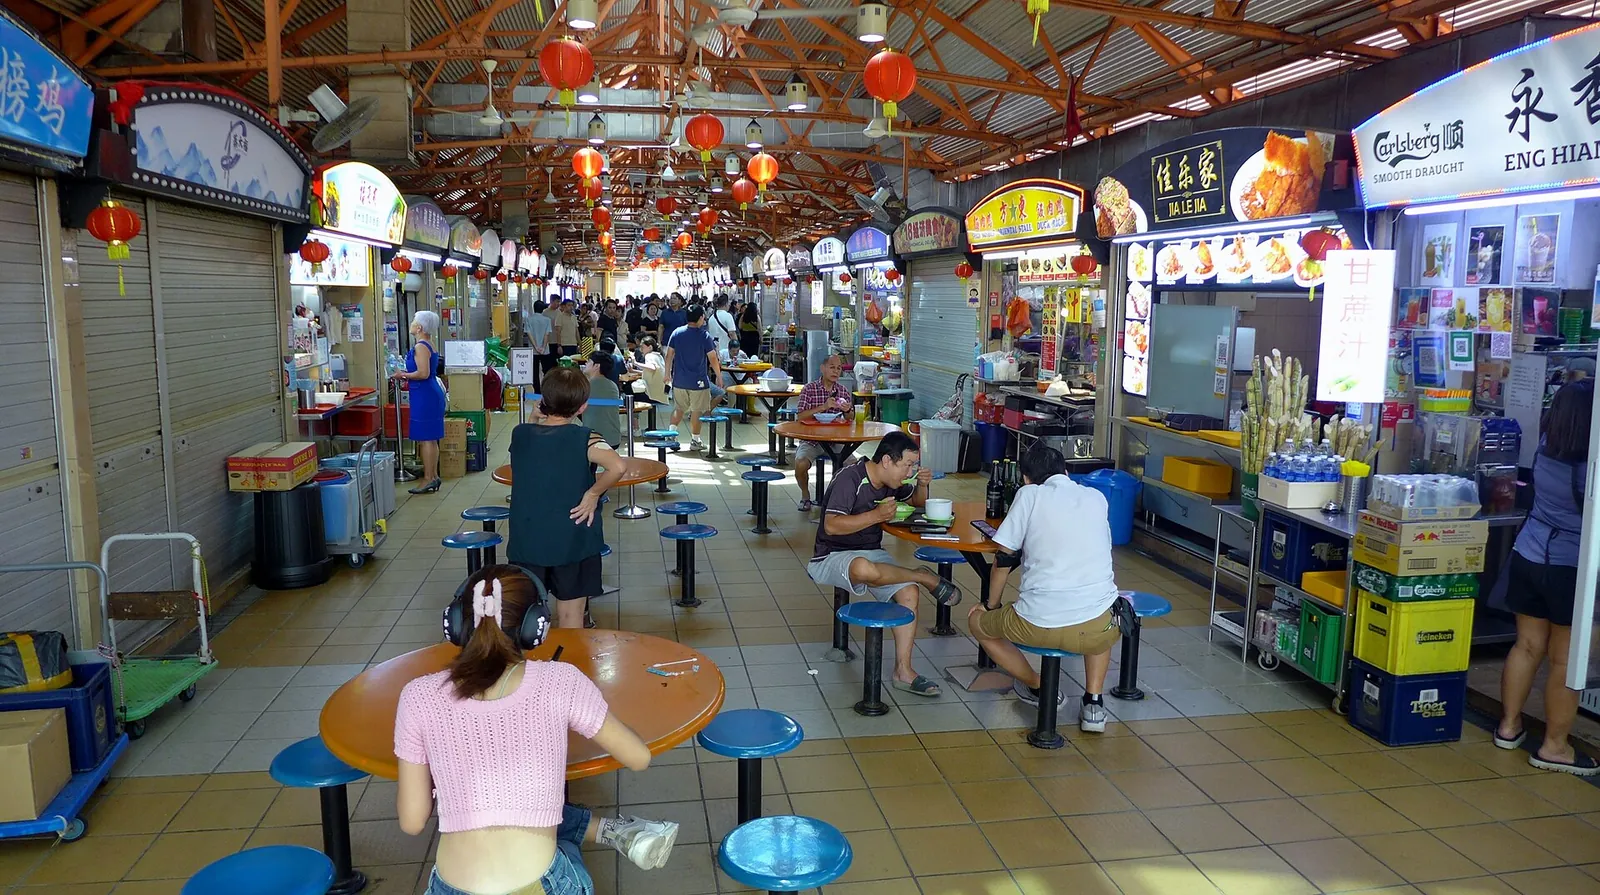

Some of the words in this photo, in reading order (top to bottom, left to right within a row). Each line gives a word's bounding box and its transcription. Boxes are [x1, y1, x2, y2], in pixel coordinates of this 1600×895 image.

[1373, 126, 1440, 163] Carlsberg
[1156, 147, 1218, 194] 佳乐家
[1504, 150, 1546, 172] ENG
[1373, 170, 1412, 184] SMOOTH
[1415, 162, 1464, 178] DRAUGHT
[1168, 202, 1181, 218] JIA
[1182, 200, 1193, 215] LE
[1194, 197, 1208, 213] JIA
[1339, 258, 1376, 359] 甘蔗汁
[1414, 584, 1446, 597] Carlsberg
[1418, 632, 1452, 642] Heineken
[1410, 700, 1447, 717] Tiger
